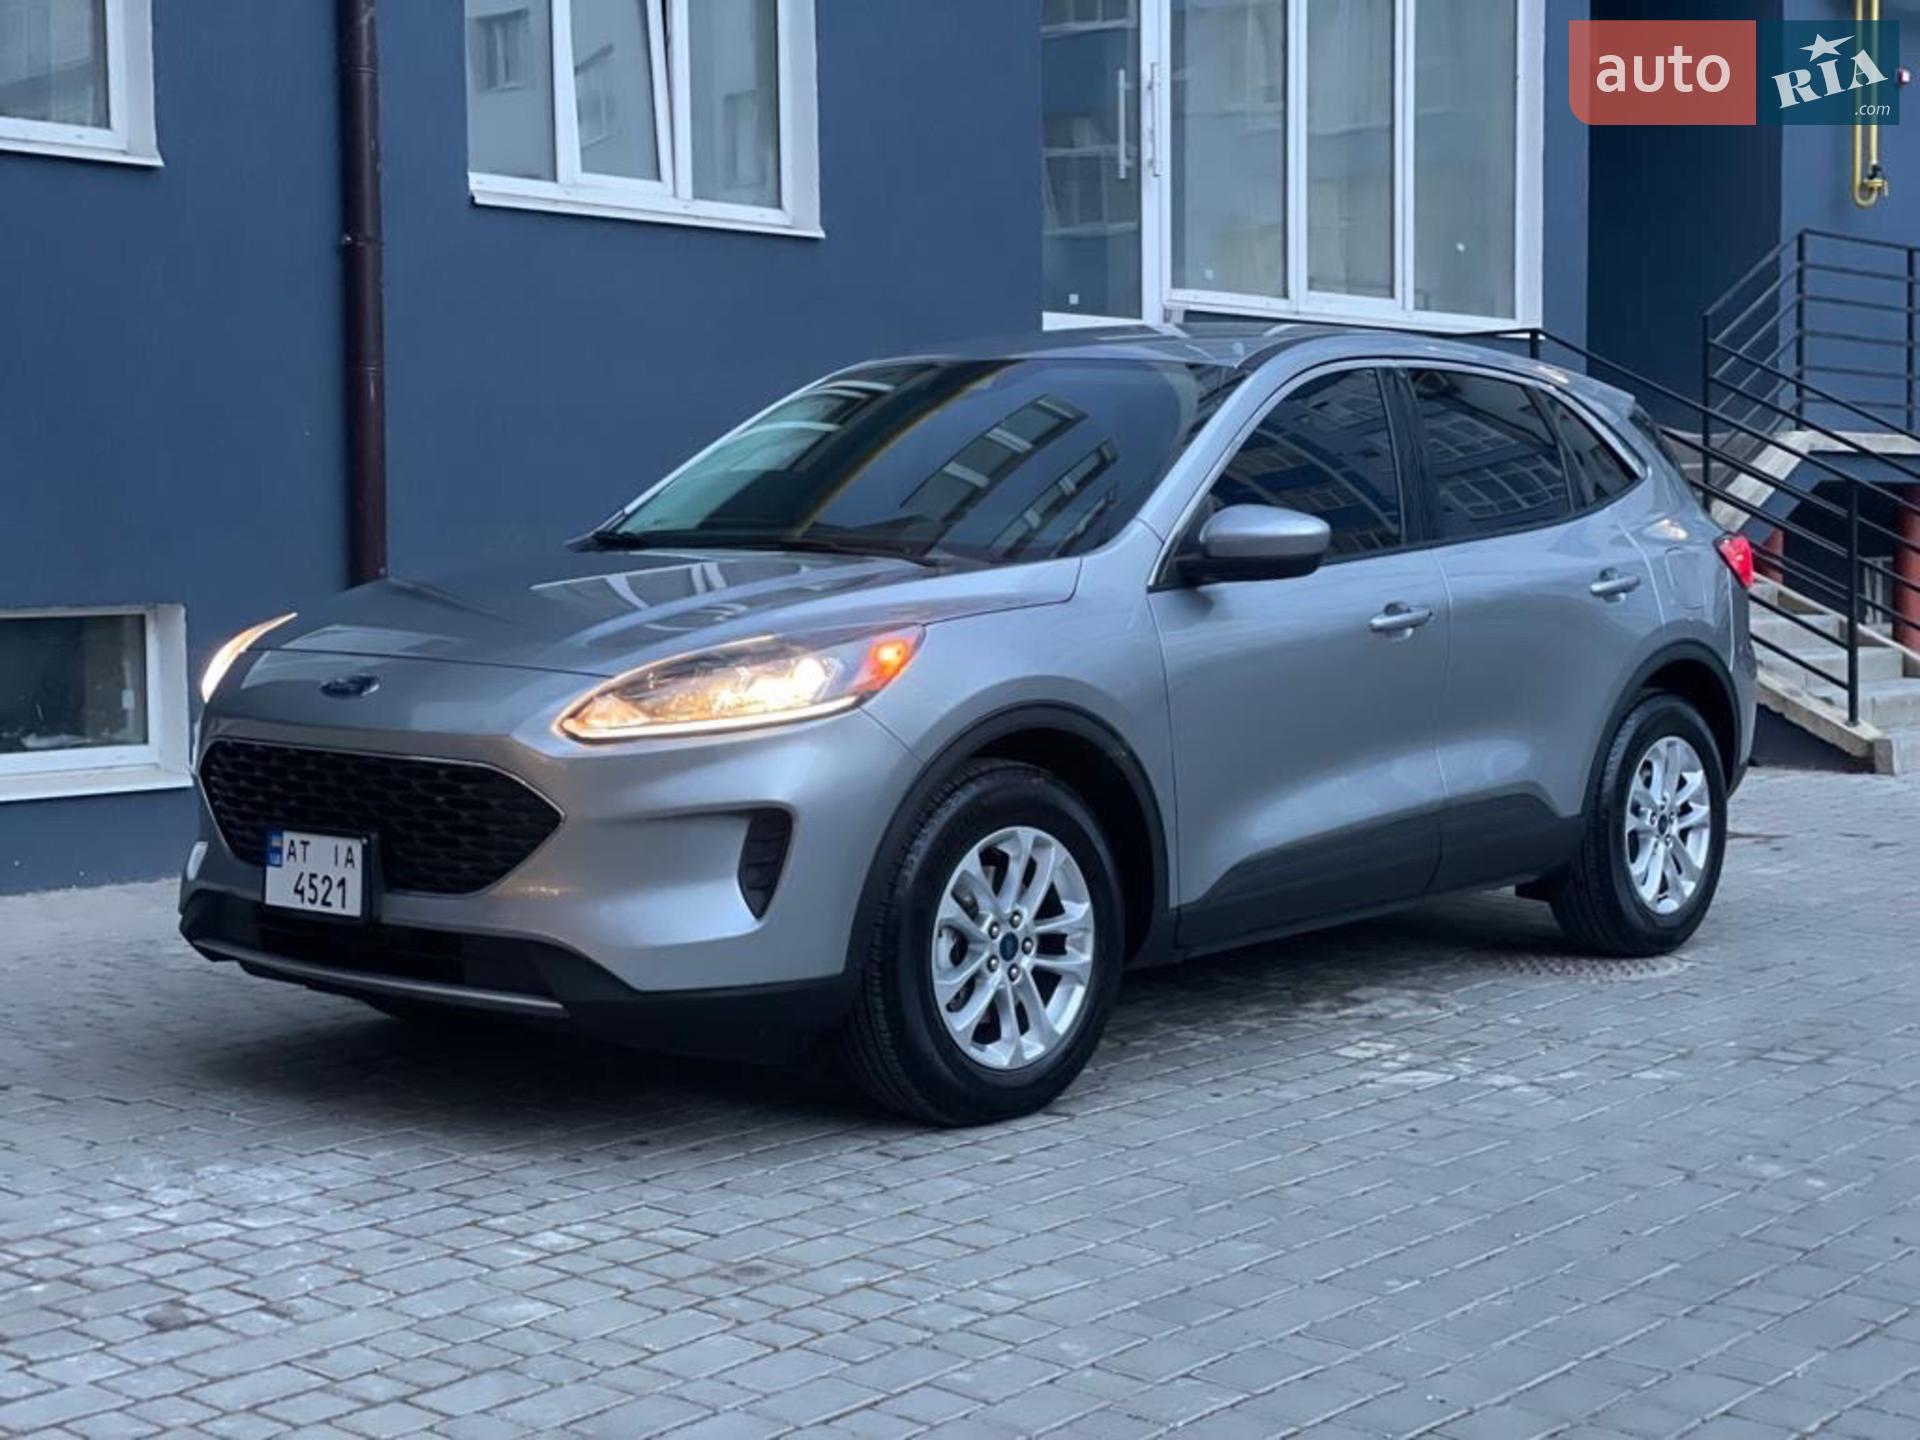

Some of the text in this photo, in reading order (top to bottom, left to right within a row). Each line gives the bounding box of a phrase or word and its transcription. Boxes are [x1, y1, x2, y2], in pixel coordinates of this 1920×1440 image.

[286, 839, 310, 863] AT
[334, 844, 355, 869] IA
[293, 871, 347, 910] 4521
